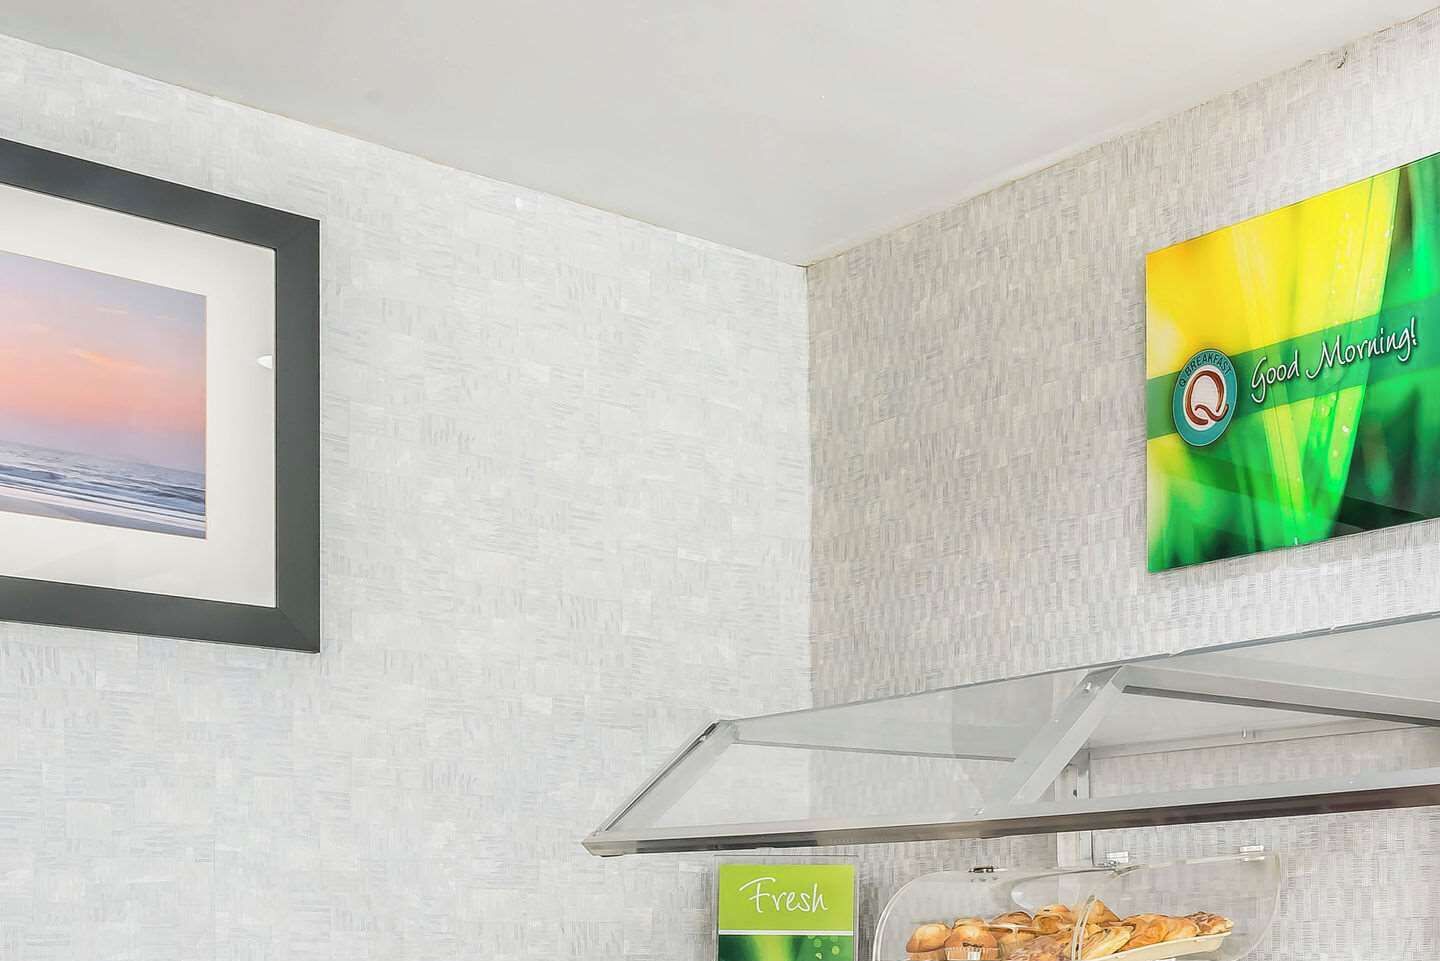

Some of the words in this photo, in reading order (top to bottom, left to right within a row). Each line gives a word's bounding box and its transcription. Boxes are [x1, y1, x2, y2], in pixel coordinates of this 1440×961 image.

[1186, 353, 1232, 377] BREAKFAST
[1251, 350, 1300, 404] Good
[1306, 317, 1418, 379] Morning!
[1185, 370, 1230, 426] Q
[739, 876, 829, 913] Fresh
